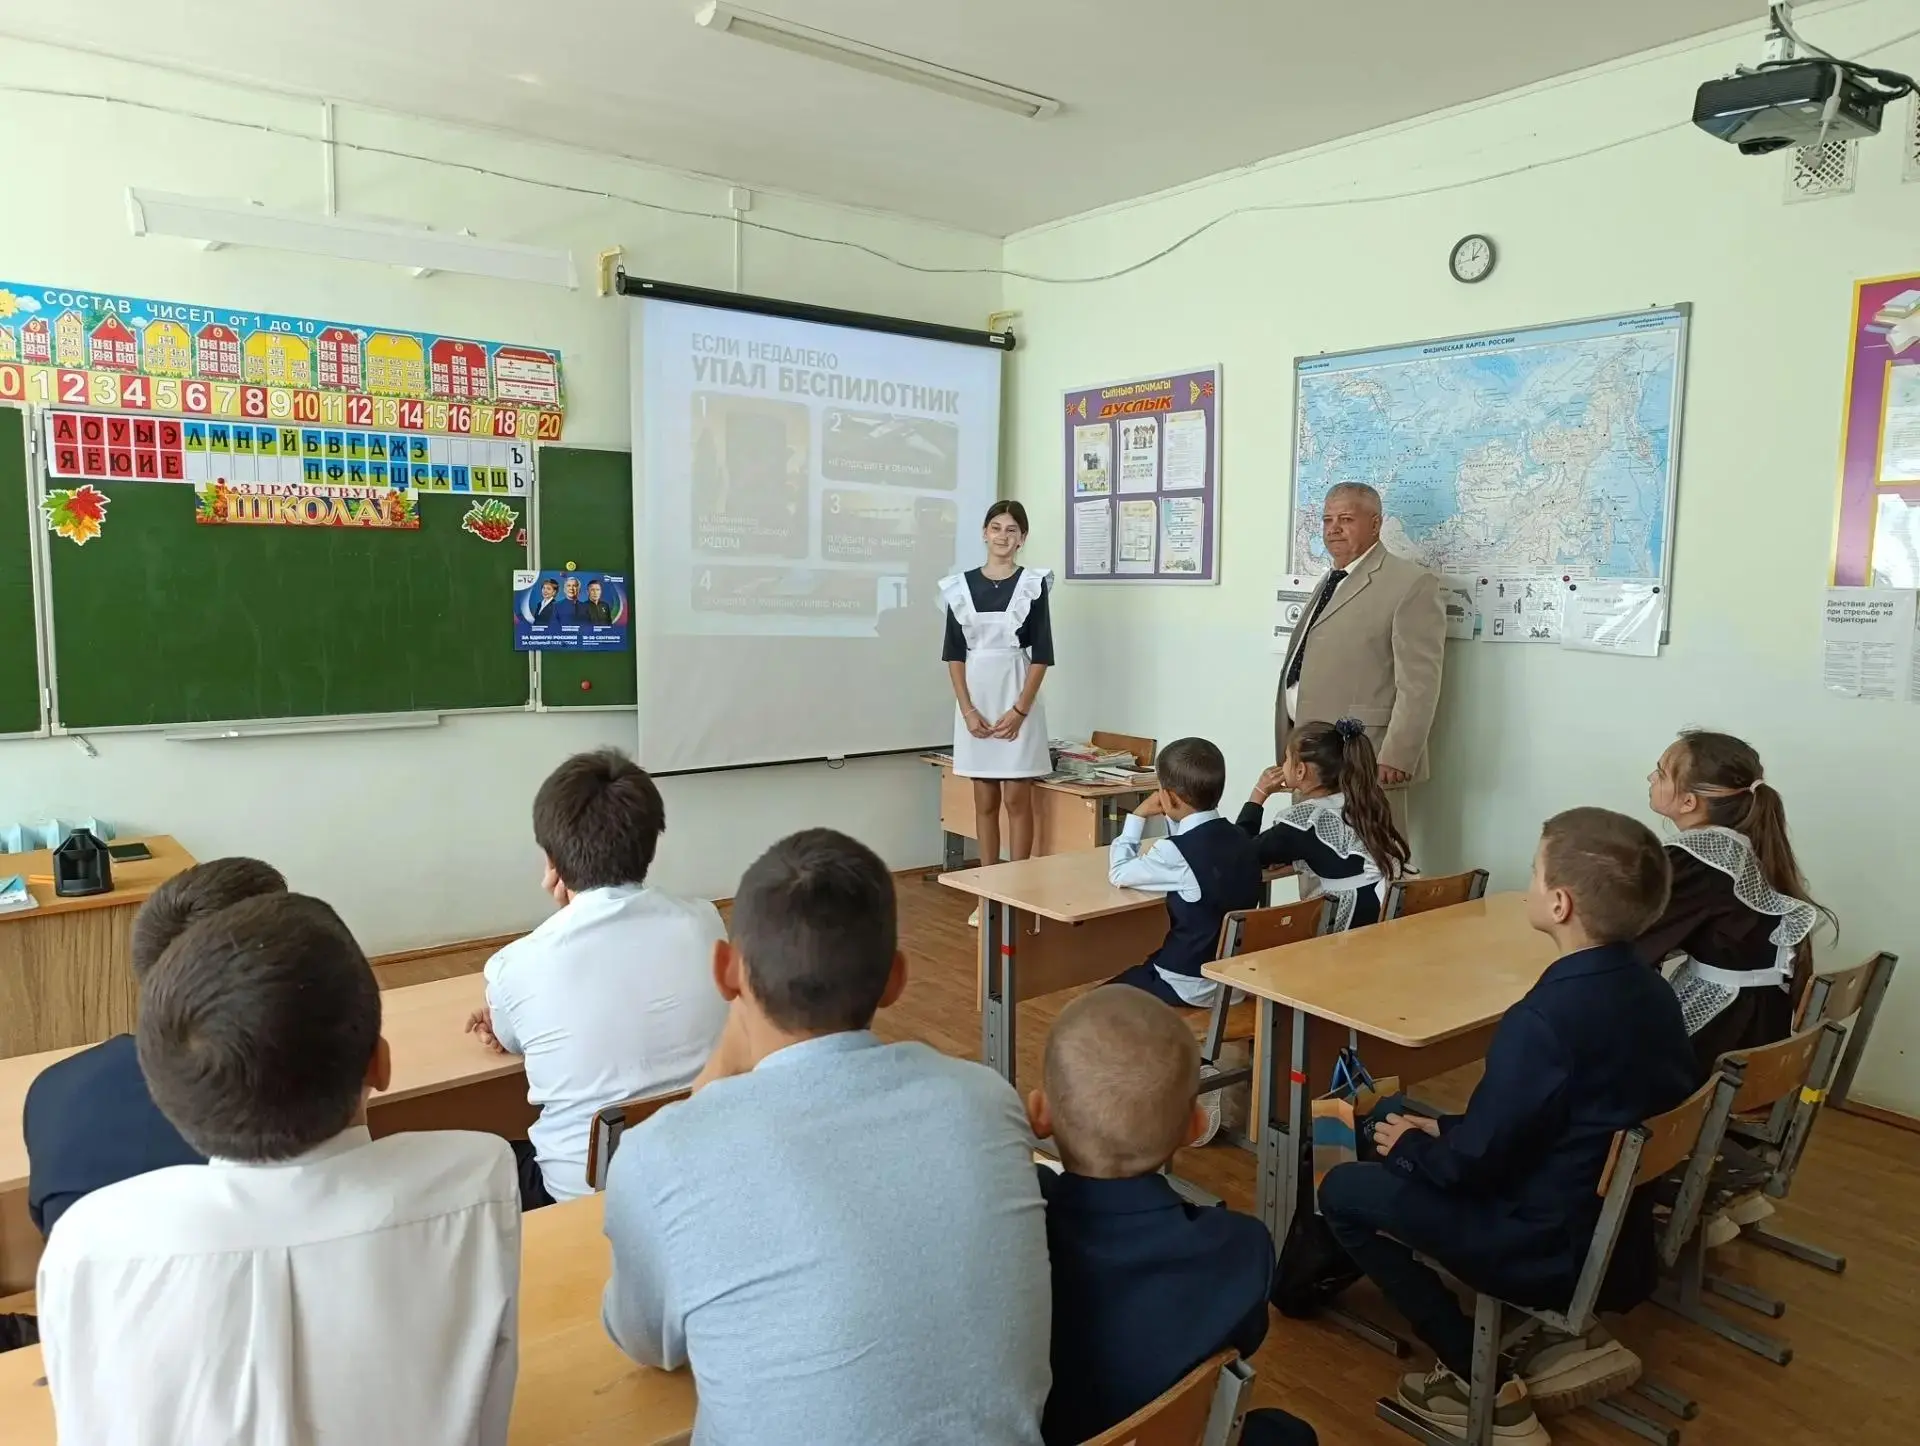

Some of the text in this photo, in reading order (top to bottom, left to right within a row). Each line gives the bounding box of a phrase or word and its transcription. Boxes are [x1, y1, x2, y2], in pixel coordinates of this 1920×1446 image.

[43, 291, 314, 334] СОСТАВ ЧИСЕЛ от 1 до 10
[692, 332, 838, 370] ЕСЛИ НЕДАЛЕКО
[1488, 337, 1515, 346] РОССИИ
[692, 355, 959, 414] УПАЛ БЕСПИЛОТНИК
[0, 366, 560, 438] 0 1 2 3 4 5 6 7 8 9 10 11 12 13 14 15 16 17 18 19 20
[1099, 395, 1173, 417] ДУСЛЫК
[831, 412, 842, 432] 2
[57, 420, 73, 439] А
[84, 421, 100, 440] О
[111, 423, 124, 441] У
[136, 424, 153, 443] Ы
[164, 426, 176, 444] Э
[211, 429, 228, 447] М
[237, 431, 250, 448] Н
[261, 432, 272, 449] Р
[282, 429, 296, 451] Й
[307, 435, 318, 452] Б
[328, 436, 340, 453] В
[351, 438, 360, 454] Г
[391, 440, 407, 457] Ж
[414, 442, 424, 458] З
[511, 447, 523, 464] Ъ
[61, 448, 524, 489] Я Ё Ю И Е П Ф К Т Ш С Х Ц Ч Щ Ь
[225, 494, 393, 527] ШКОЛА!
[830, 493, 841, 514] 3
[516, 528, 528, 546] 4
[700, 570, 711, 591] 4
